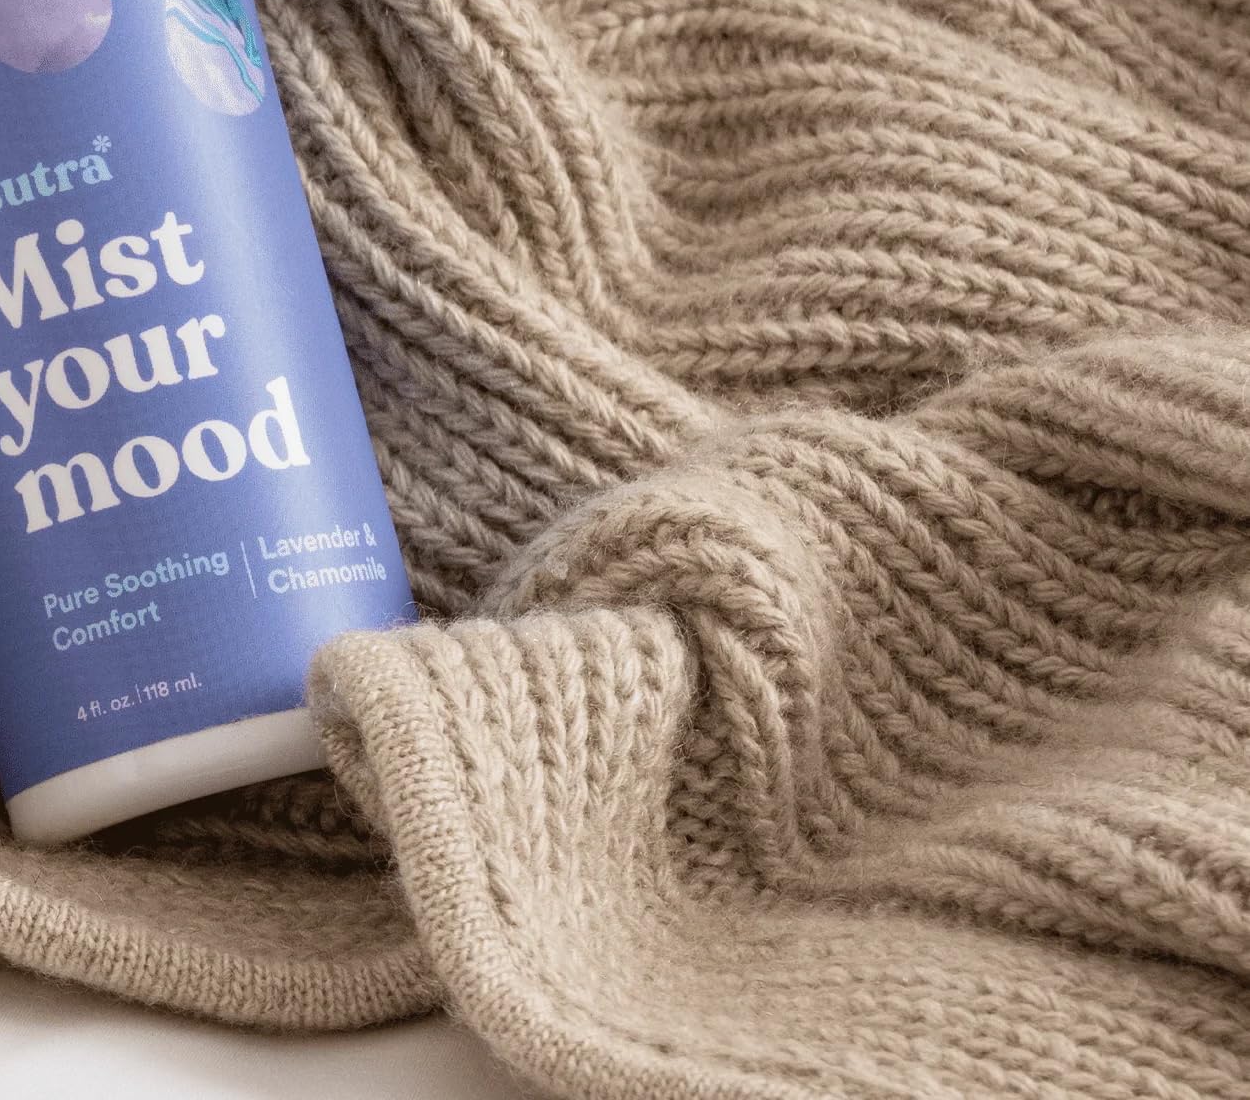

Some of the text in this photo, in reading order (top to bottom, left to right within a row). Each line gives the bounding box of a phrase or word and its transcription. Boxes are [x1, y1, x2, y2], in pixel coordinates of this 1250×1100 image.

[14, 376, 310, 533] mood
[257, 522, 377, 560] Lavender &
[43, 551, 230, 619] Pure Soothing
[268, 556, 387, 594] Chamomile
[52, 601, 161, 651] Comfort
[77, 672, 203, 722] 4 fl. oz. 118 ml.
